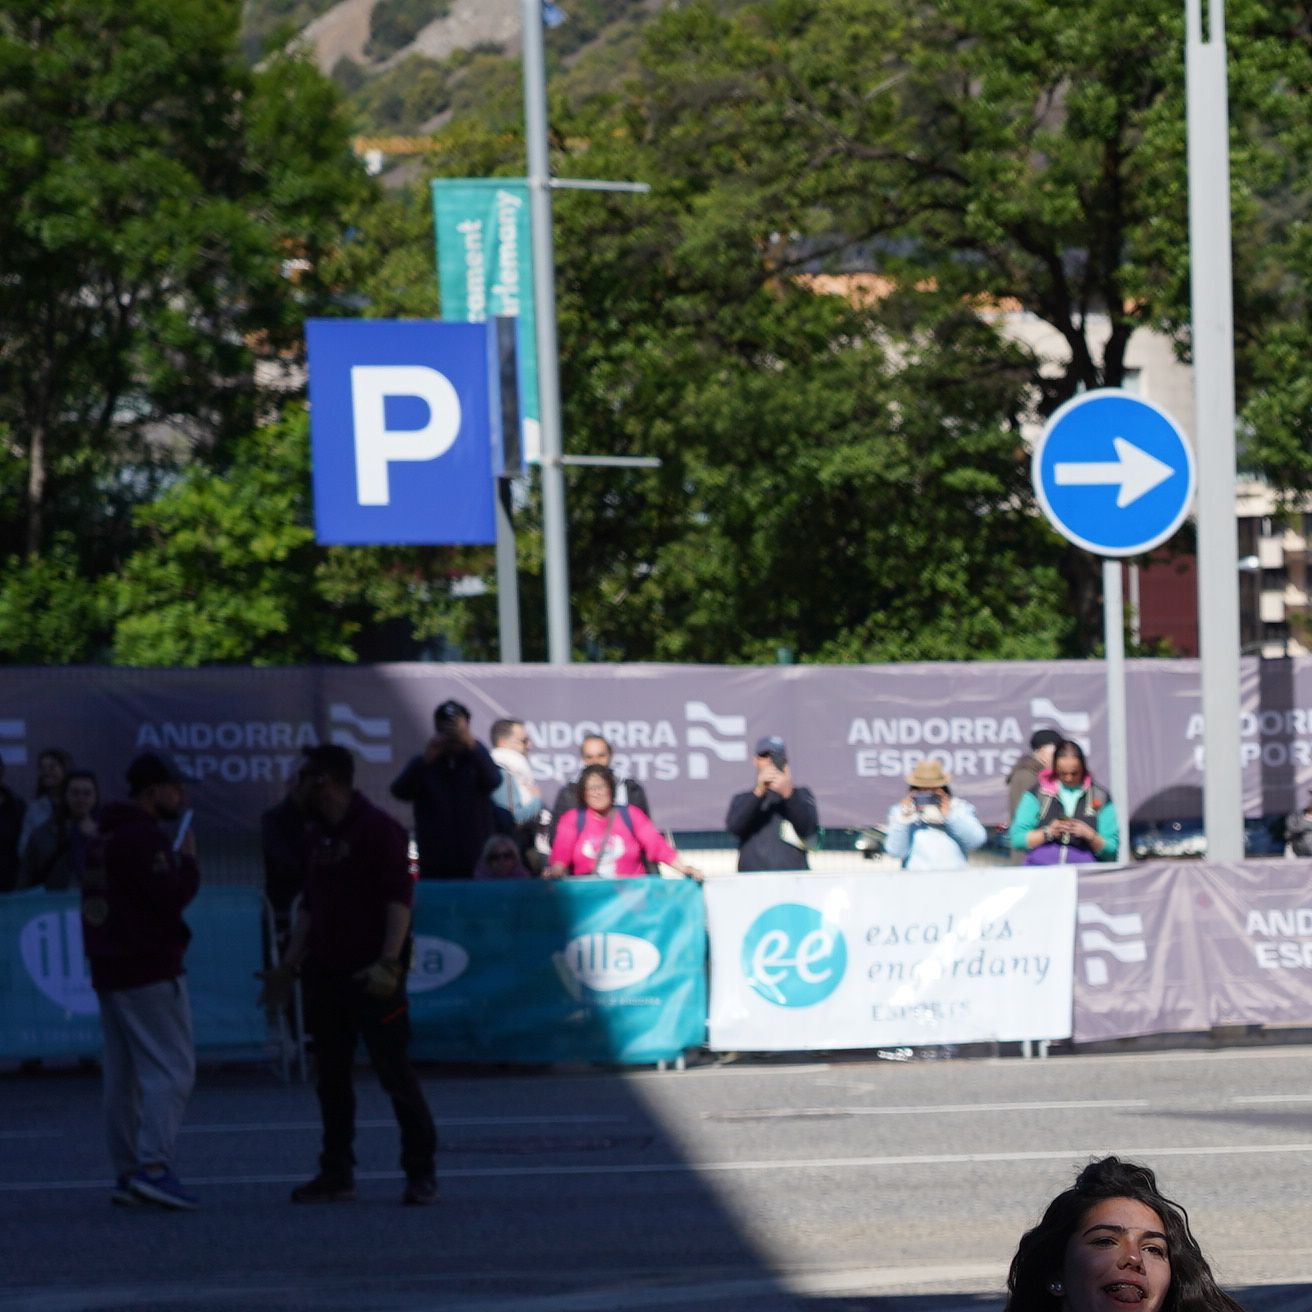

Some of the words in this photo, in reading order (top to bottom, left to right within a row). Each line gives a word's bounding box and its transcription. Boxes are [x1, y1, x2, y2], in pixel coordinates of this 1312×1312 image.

[491, 190, 523, 316] arlemany
[351, 365, 462, 506] P
[136, 722, 320, 747] ANDORRA
[525, 720, 678, 748] NDORRA
[848, 717, 1024, 744] ANDORRA
[174, 754, 302, 782] SPORT
[527, 752, 679, 780] SPRTS
[577, 932, 635, 972] illa
